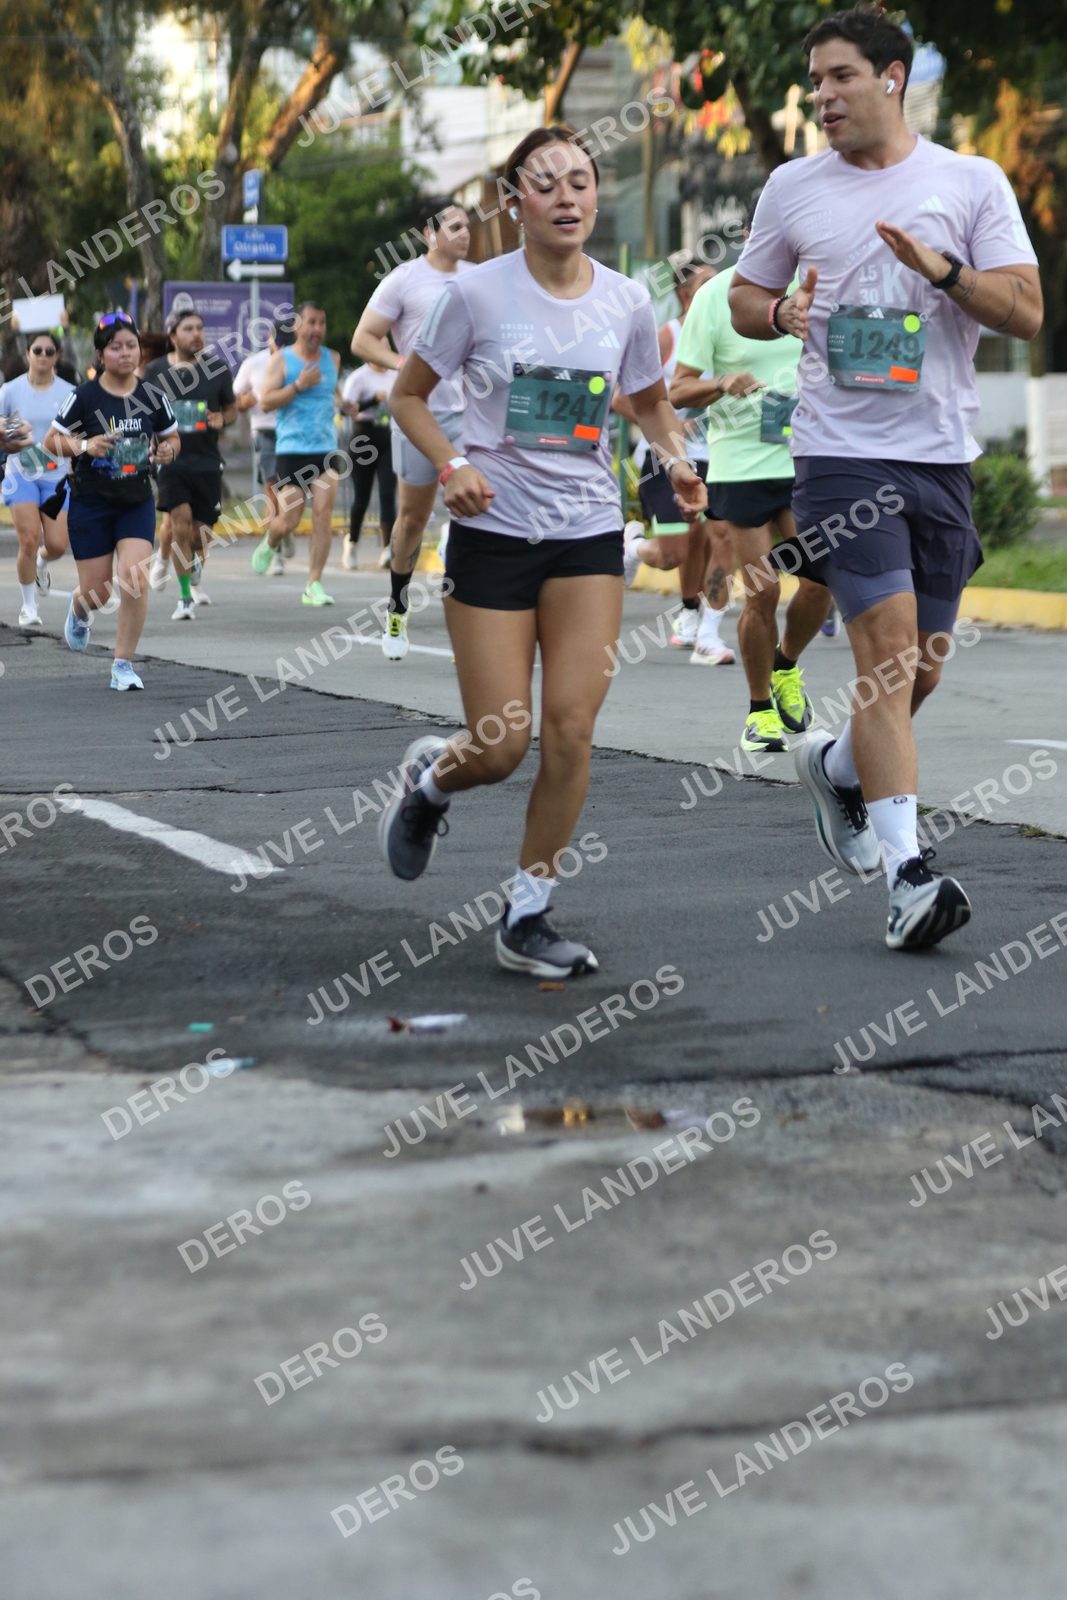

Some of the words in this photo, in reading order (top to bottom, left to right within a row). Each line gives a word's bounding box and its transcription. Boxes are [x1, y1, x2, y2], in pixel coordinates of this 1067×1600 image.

[859, 264, 877, 282] 15
[881, 262, 908, 304] K
[860, 288, 879, 305] 30
[849, 328, 920, 363] 1249
[535, 390, 604, 425] 1247
